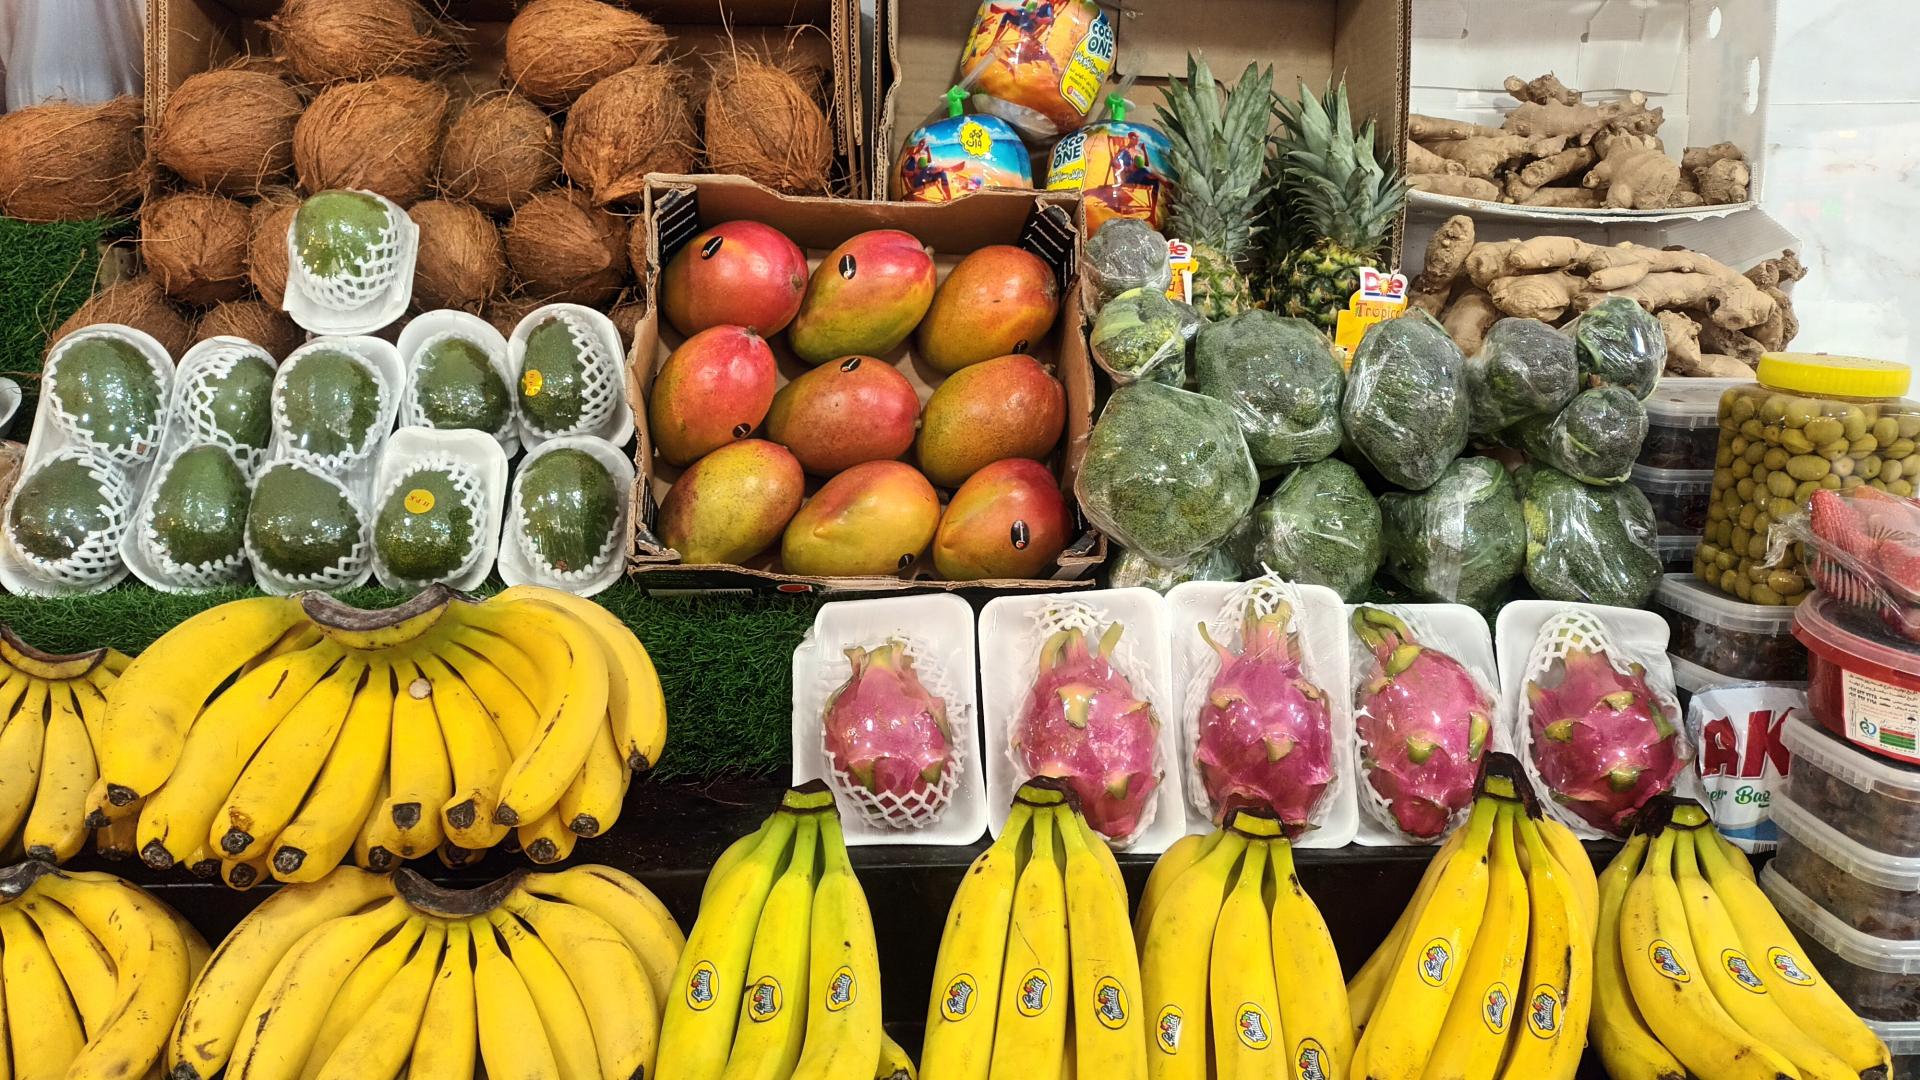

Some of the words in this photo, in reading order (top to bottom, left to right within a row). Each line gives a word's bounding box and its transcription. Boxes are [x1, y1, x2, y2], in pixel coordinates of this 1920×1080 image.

[1088, 36, 1113, 59] ONE
[1055, 135, 1085, 154] COCO
[1053, 145, 1082, 169] ONE
